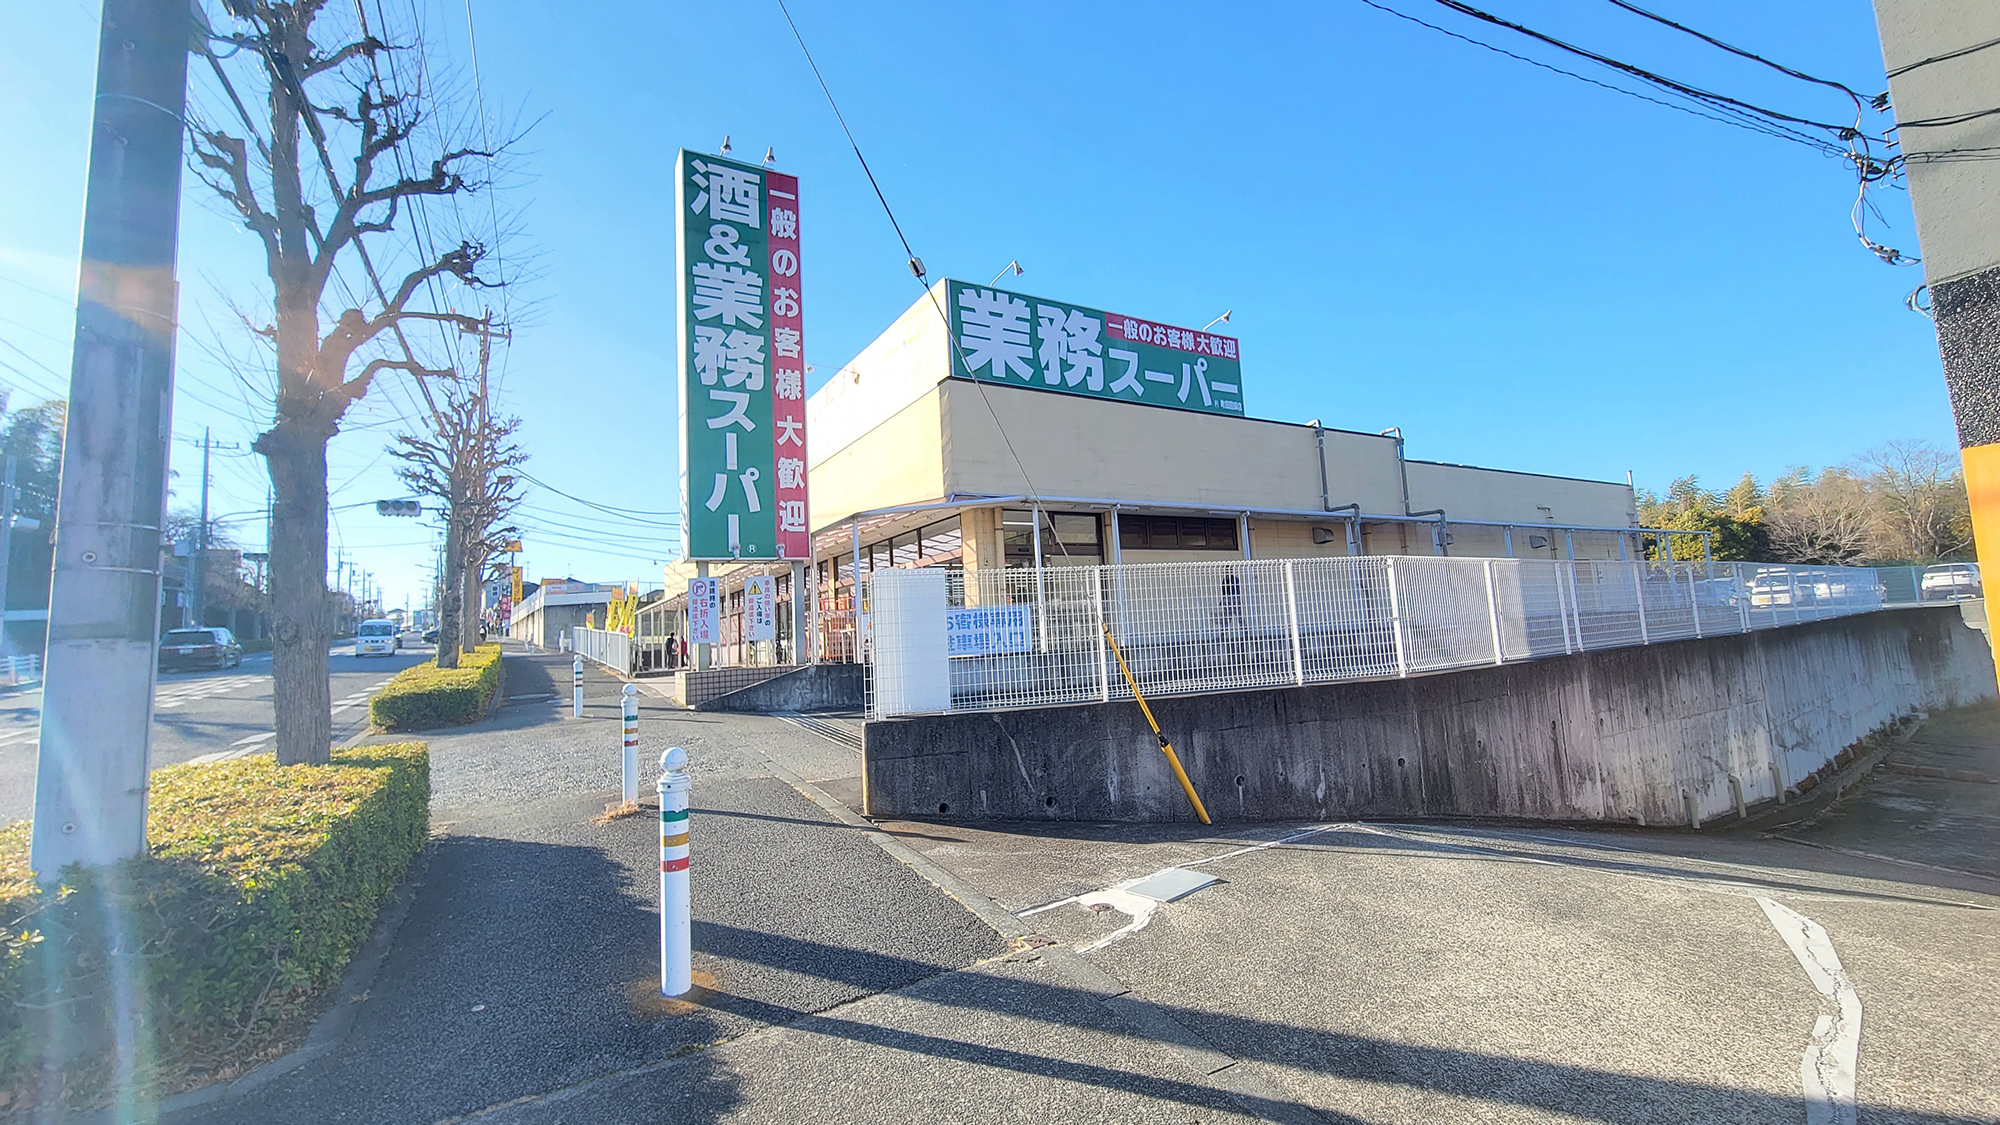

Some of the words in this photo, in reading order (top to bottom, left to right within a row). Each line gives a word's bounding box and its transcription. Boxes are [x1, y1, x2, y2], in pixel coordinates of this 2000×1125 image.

[690, 158, 764, 552] 酒&業務スーパー
[769, 187, 806, 533] 一般のお客様大歓迎
[957, 288, 1239, 407] 業務スーパー
[700, 598, 709, 640] 右折入場
